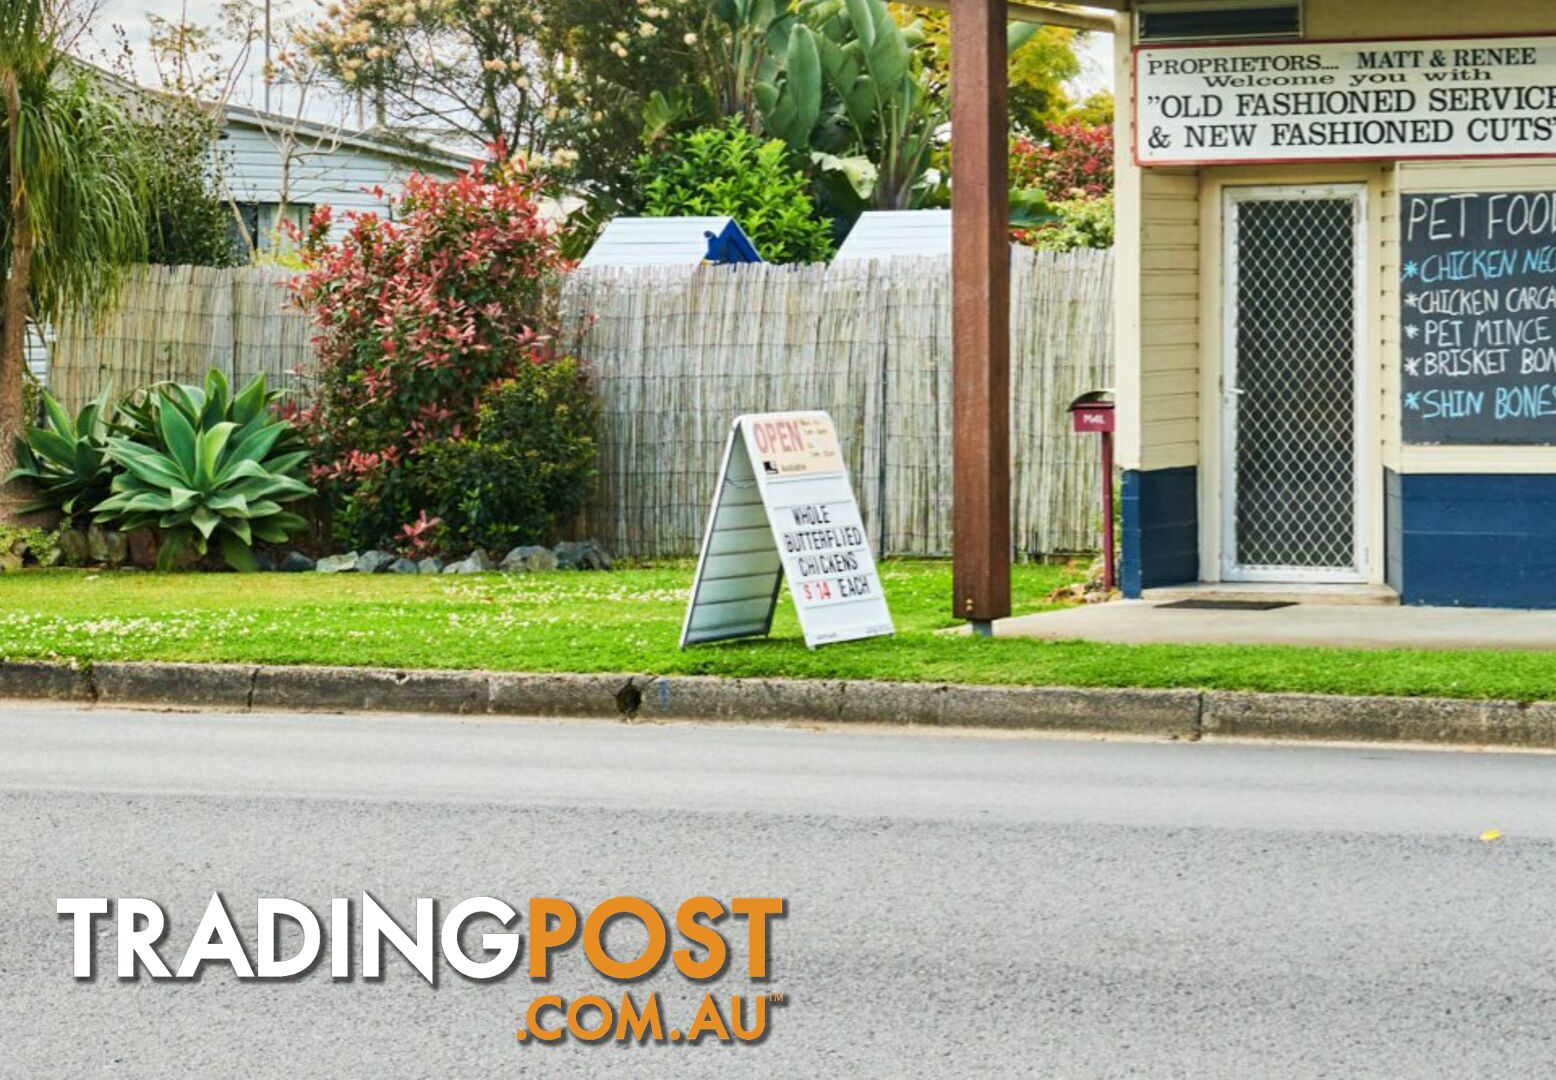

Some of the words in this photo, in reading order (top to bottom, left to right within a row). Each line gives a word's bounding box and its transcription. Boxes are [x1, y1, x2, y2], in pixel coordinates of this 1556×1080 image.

[1357, 50, 1423, 69] MATT
[1429, 50, 1446, 68] &
[1454, 47, 1536, 66] RENEE
[1203, 74, 1335, 88] Welcome
[1349, 72, 1407, 87] you
[1424, 68, 1492, 81] with
[1236, 89, 1416, 116] FASHIONED
[1148, 126, 1171, 149] &
[1184, 124, 1257, 147] NEW
[1271, 119, 1454, 145] FASHIONED
[1408, 194, 1478, 241] PET
[1421, 249, 1517, 282] CHICKEN
[1418, 288, 1498, 315] CHICKEN
[1424, 320, 1462, 346] PET
[1474, 317, 1551, 347] MINCE
[1424, 348, 1509, 376] BRISKET
[1422, 389, 1483, 418] SHIN
[753, 421, 804, 453] OPEN
[793, 506, 830, 525] WHOLE
[785, 527, 861, 552] BUTTERFLIED
[799, 552, 857, 576] CHICKENS
[838, 576, 870, 597] EACH
